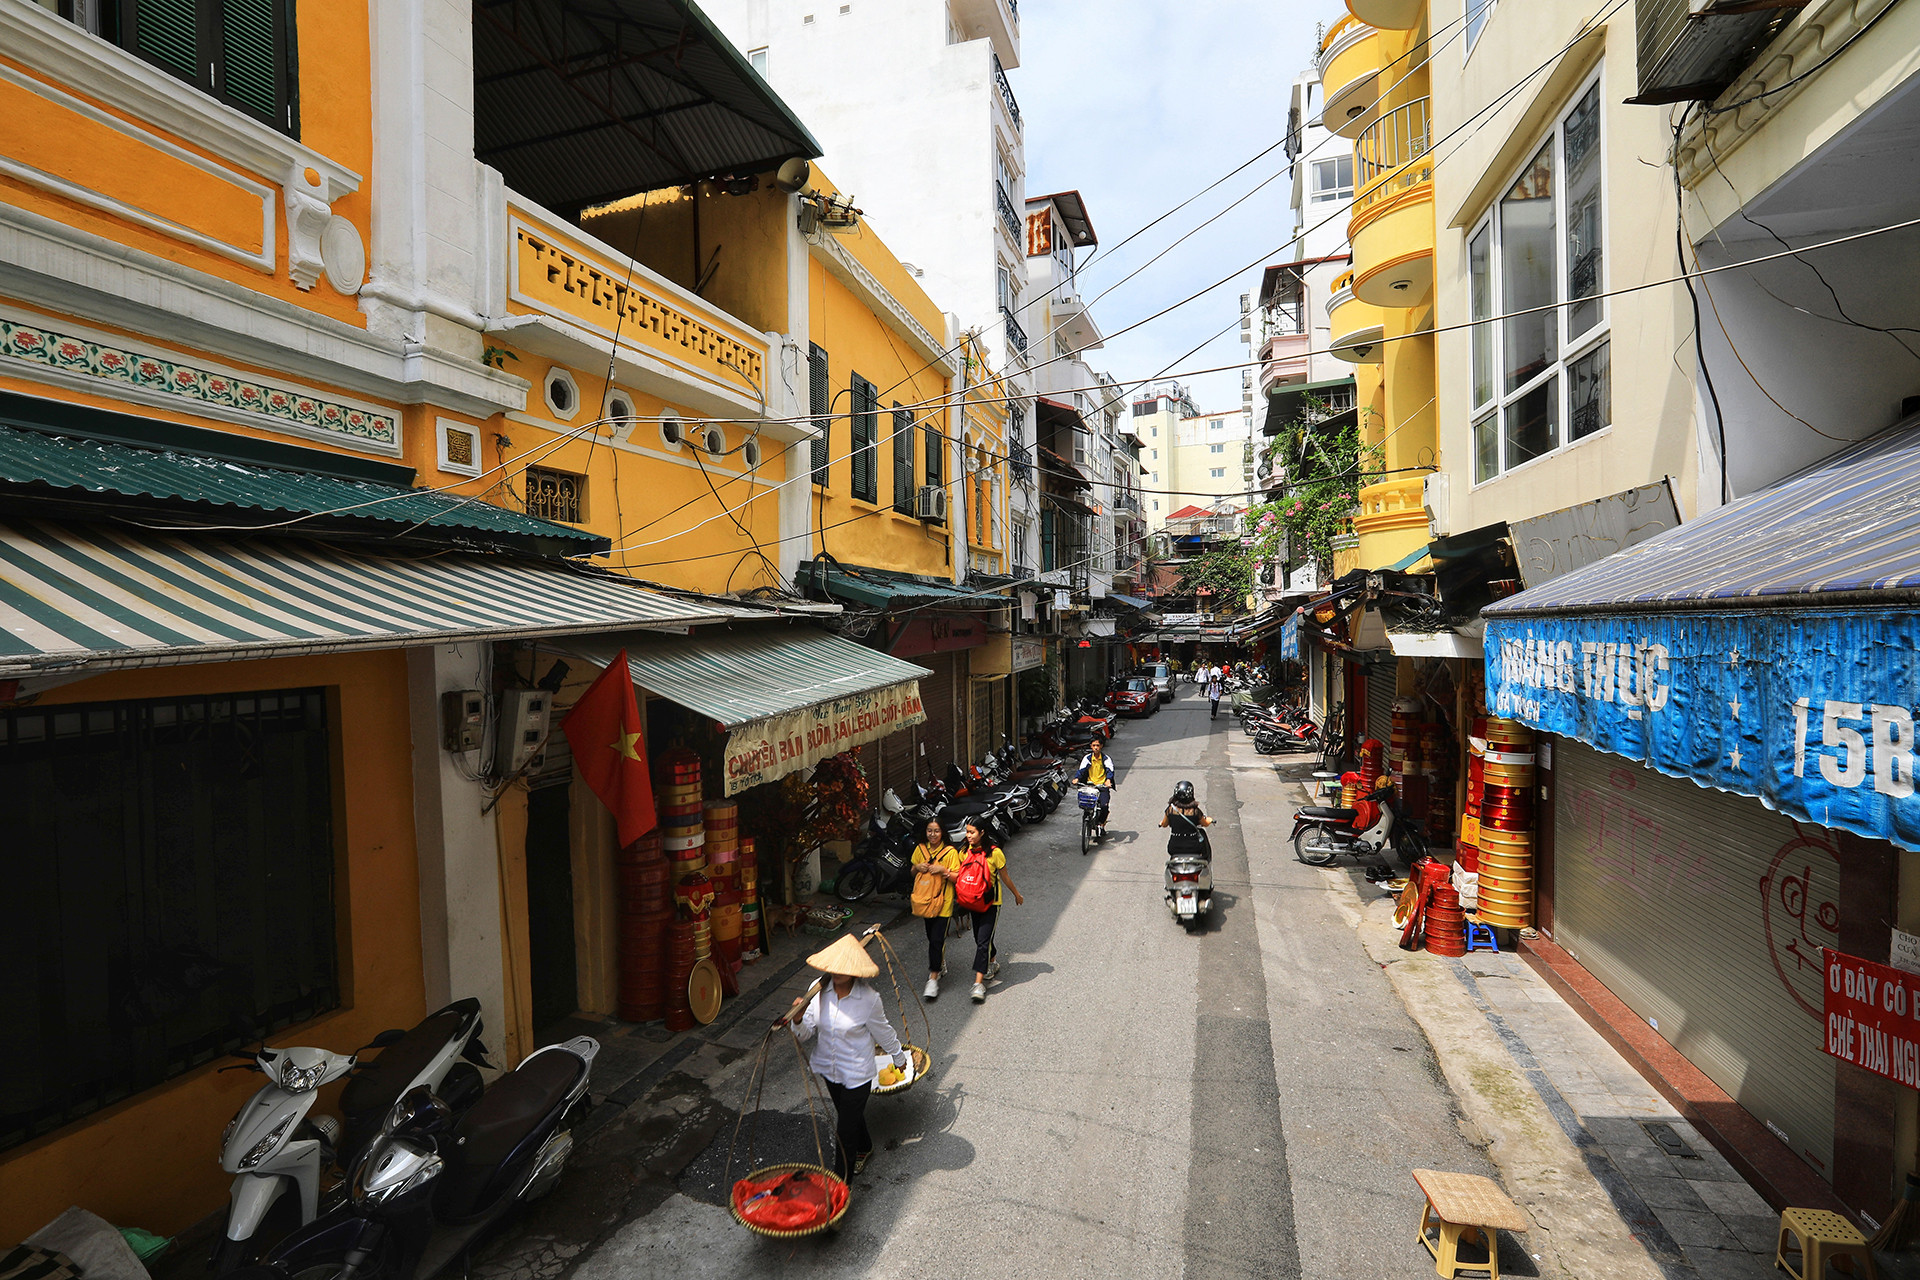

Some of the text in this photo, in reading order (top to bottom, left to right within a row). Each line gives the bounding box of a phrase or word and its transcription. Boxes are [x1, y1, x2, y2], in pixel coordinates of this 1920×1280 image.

[1582, 637, 1669, 720] THỰC
[779, 731, 805, 762] BÁN
[1792, 697, 1915, 799] 15B
[1829, 952, 1842, 994] Ở
[1844, 966, 1879, 1007] ĐÂY
[1883, 979, 1907, 1017] CÓ
[1828, 1009, 1856, 1061] CHÈ
[1858, 1020, 1889, 1076] THÁI
